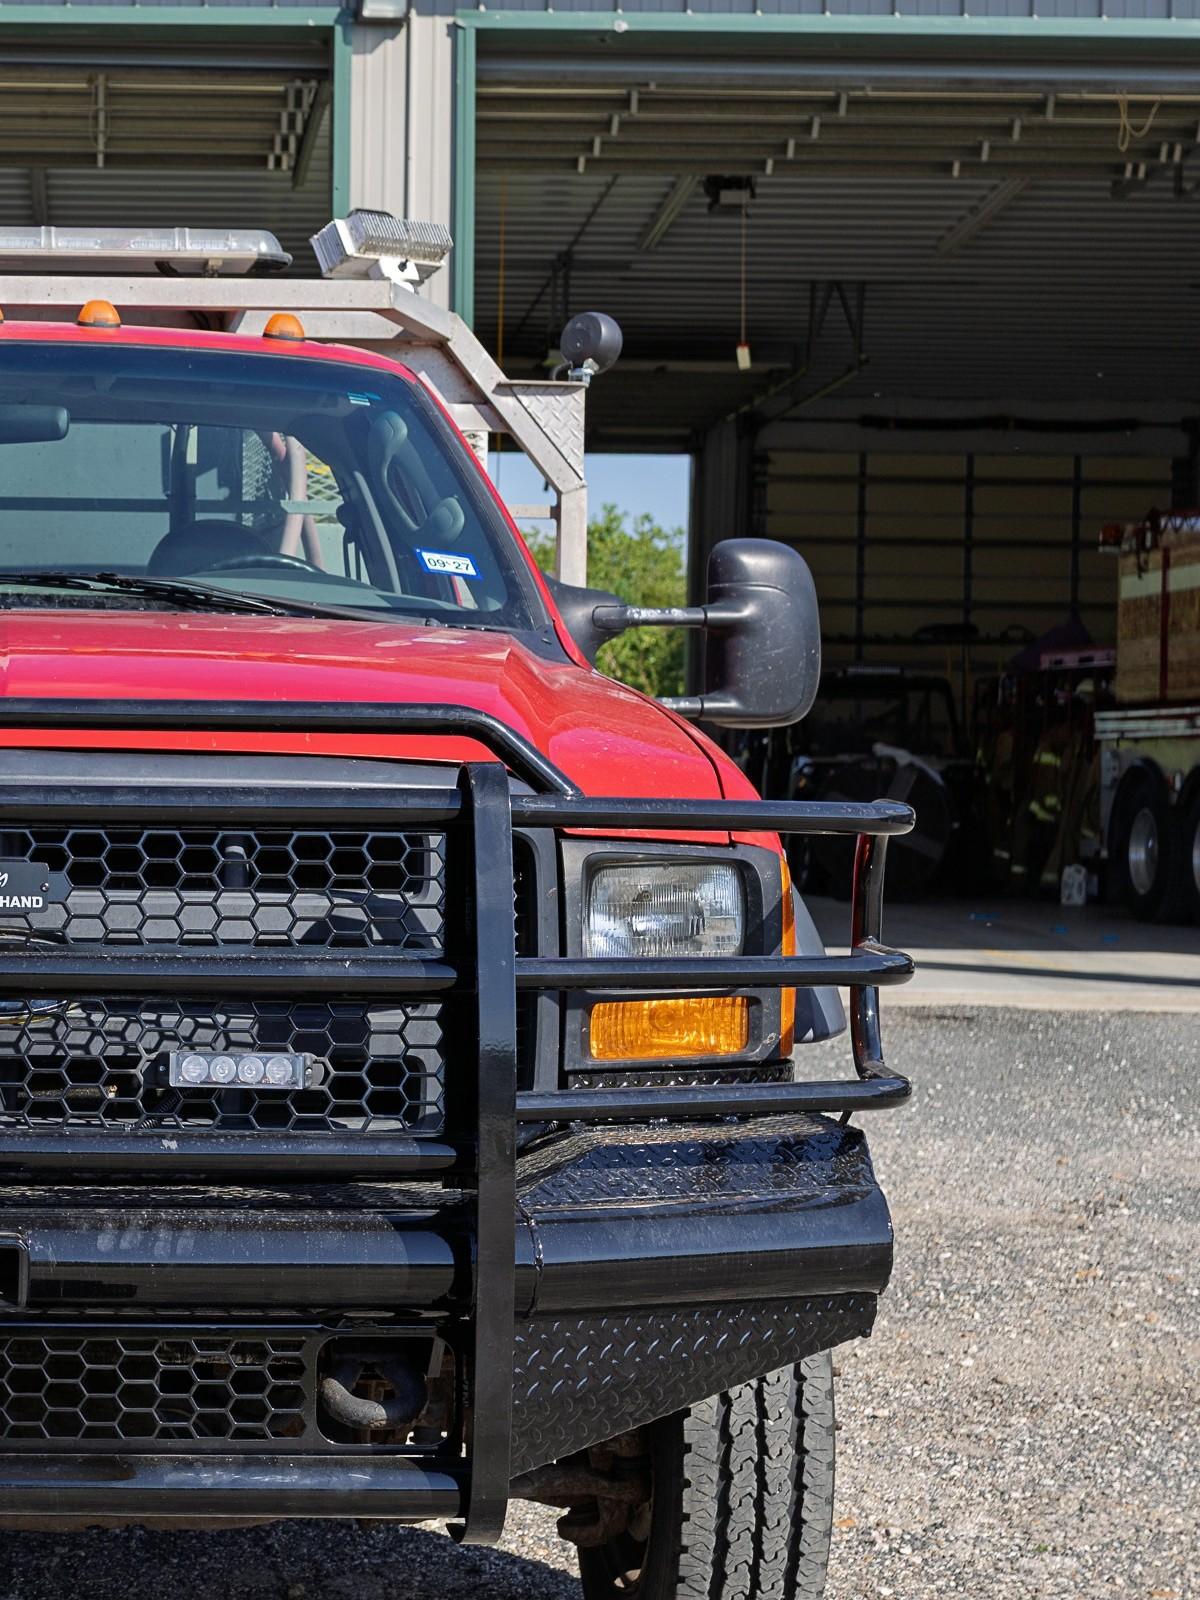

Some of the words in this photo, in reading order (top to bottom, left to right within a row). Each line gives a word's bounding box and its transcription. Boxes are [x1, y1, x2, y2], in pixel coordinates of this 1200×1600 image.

[427, 558, 446, 568] 09
[452, 561, 470, 571] 27
[0, 895, 43, 908] HAND
